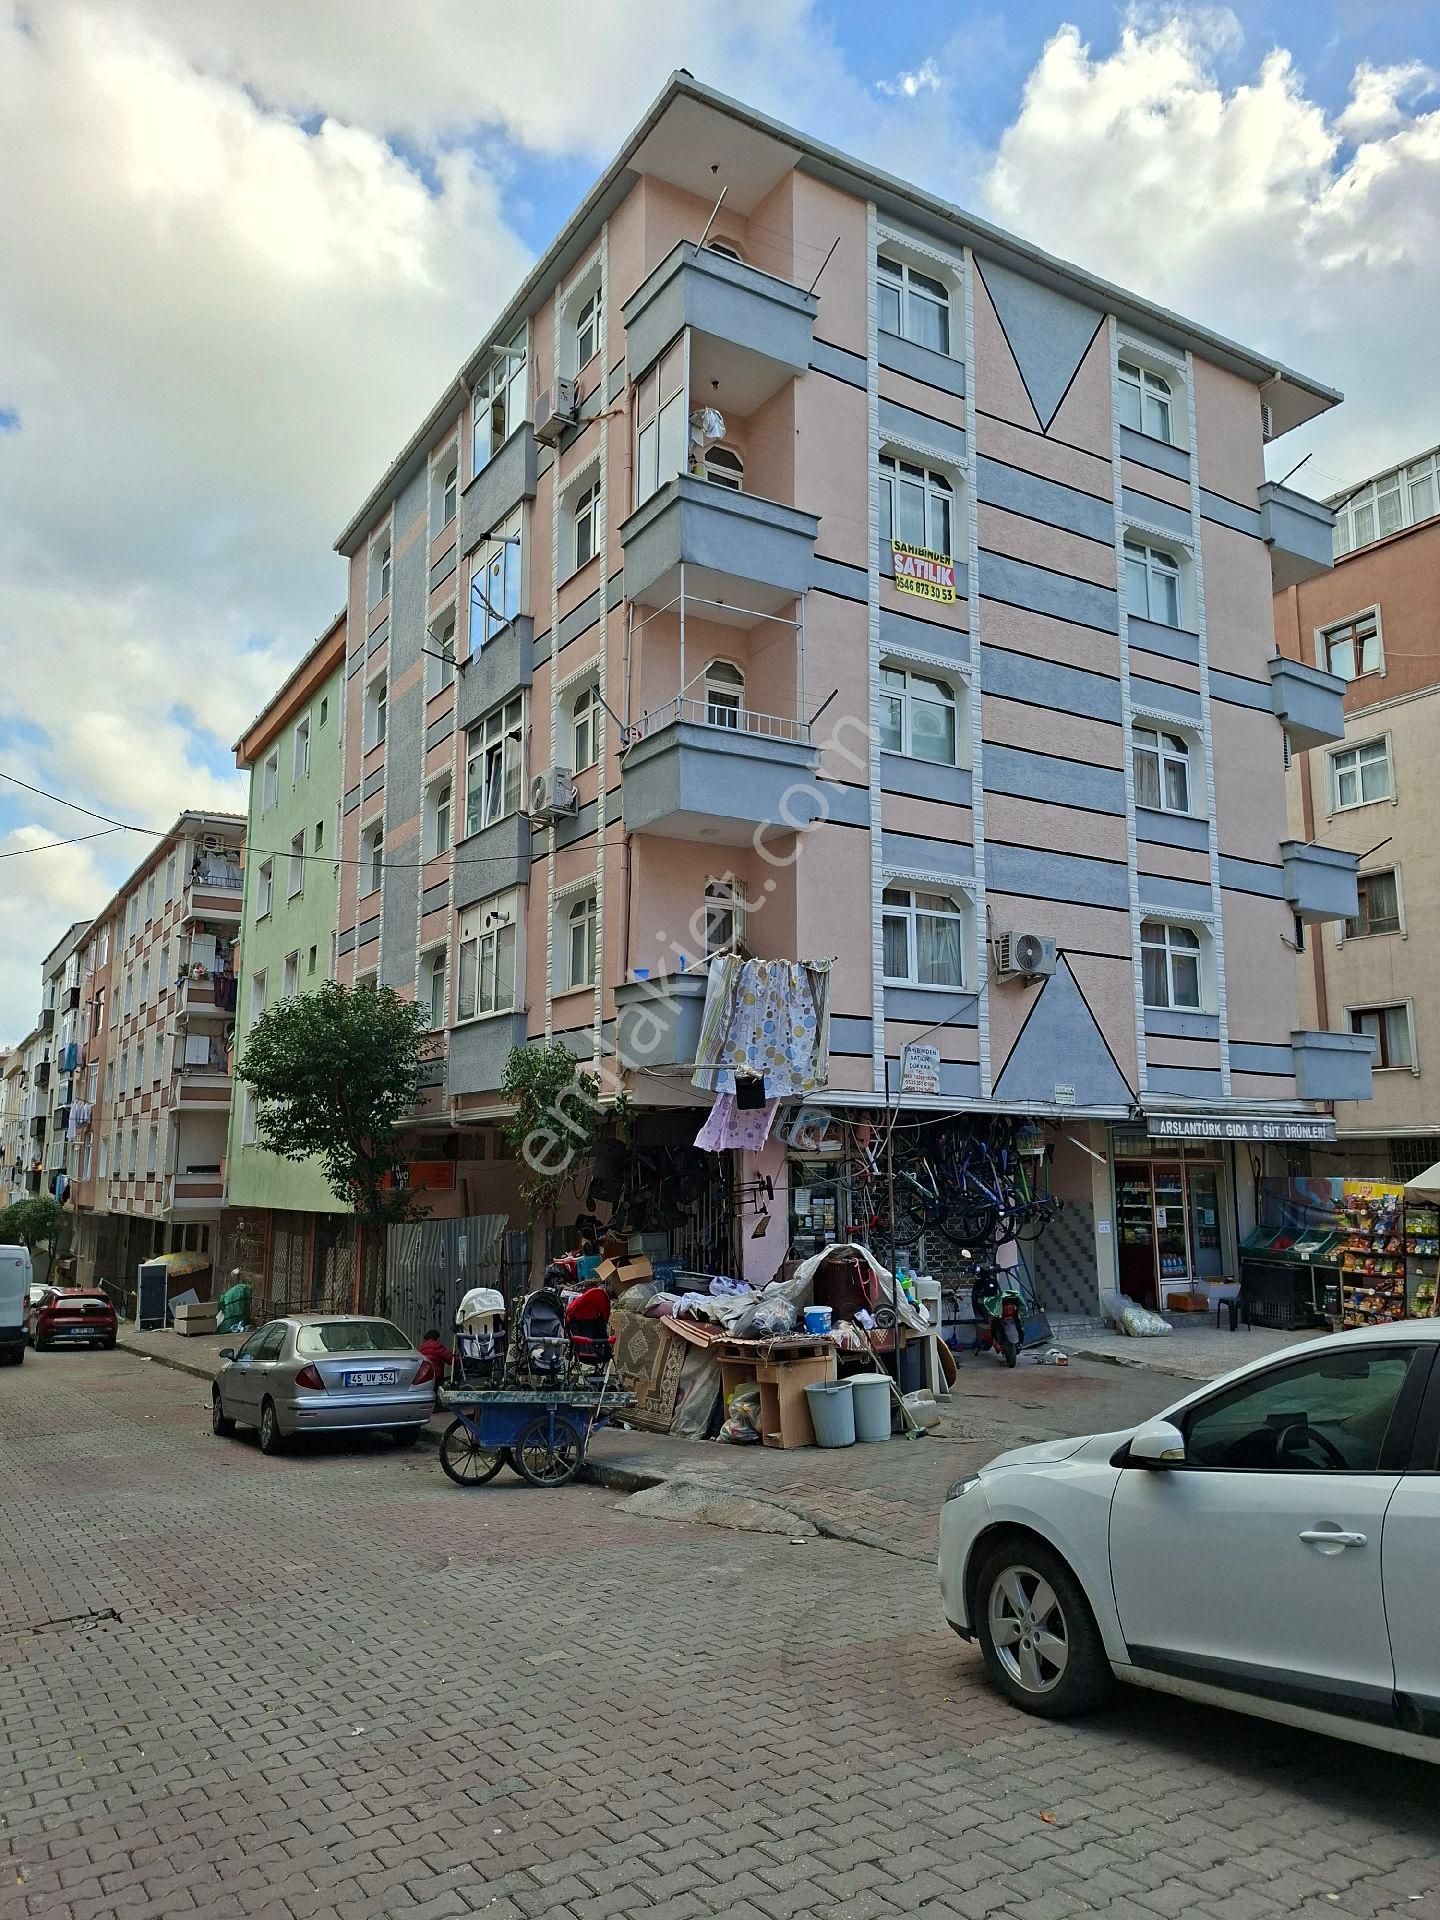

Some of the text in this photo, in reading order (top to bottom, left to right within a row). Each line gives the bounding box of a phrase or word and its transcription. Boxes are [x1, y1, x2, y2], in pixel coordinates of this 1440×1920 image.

[894, 553, 953, 586] SATILIK
[896, 575, 953, 601] 0546 873 30 53
[1160, 1120, 1222, 1136] ARSLANTÜRK
[1226, 1124, 1248, 1137] GIDA
[1252, 1125, 1259, 1136] &
[1263, 1124, 1280, 1138] SÜT
[352, 1374, 362, 1383] 45
[379, 1373, 393, 1382] 354
